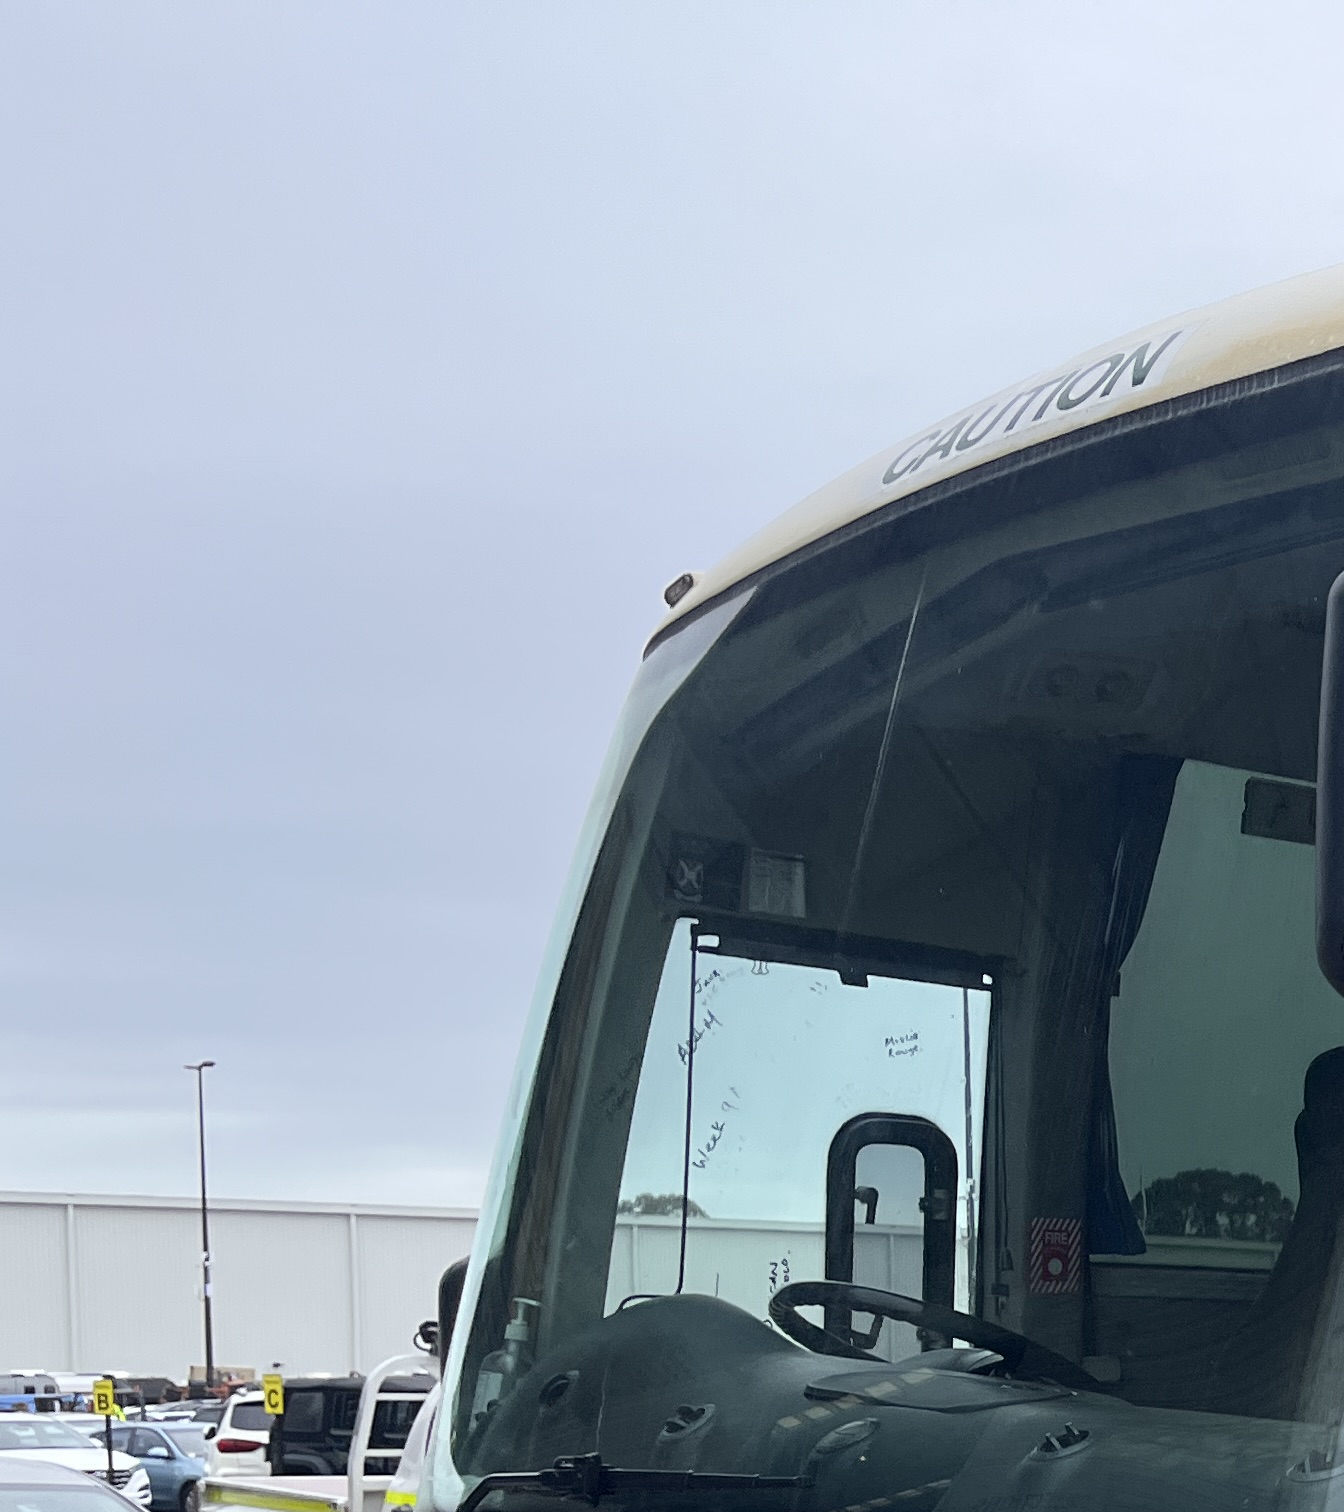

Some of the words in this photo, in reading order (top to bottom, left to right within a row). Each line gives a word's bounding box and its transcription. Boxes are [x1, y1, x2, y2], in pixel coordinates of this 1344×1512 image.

[881, 330, 1183, 485] CAUTION
[1044, 1231, 1069, 1245] FIRE
[97, 1393, 109, 1410] B
[267, 1389, 279, 1408] C
